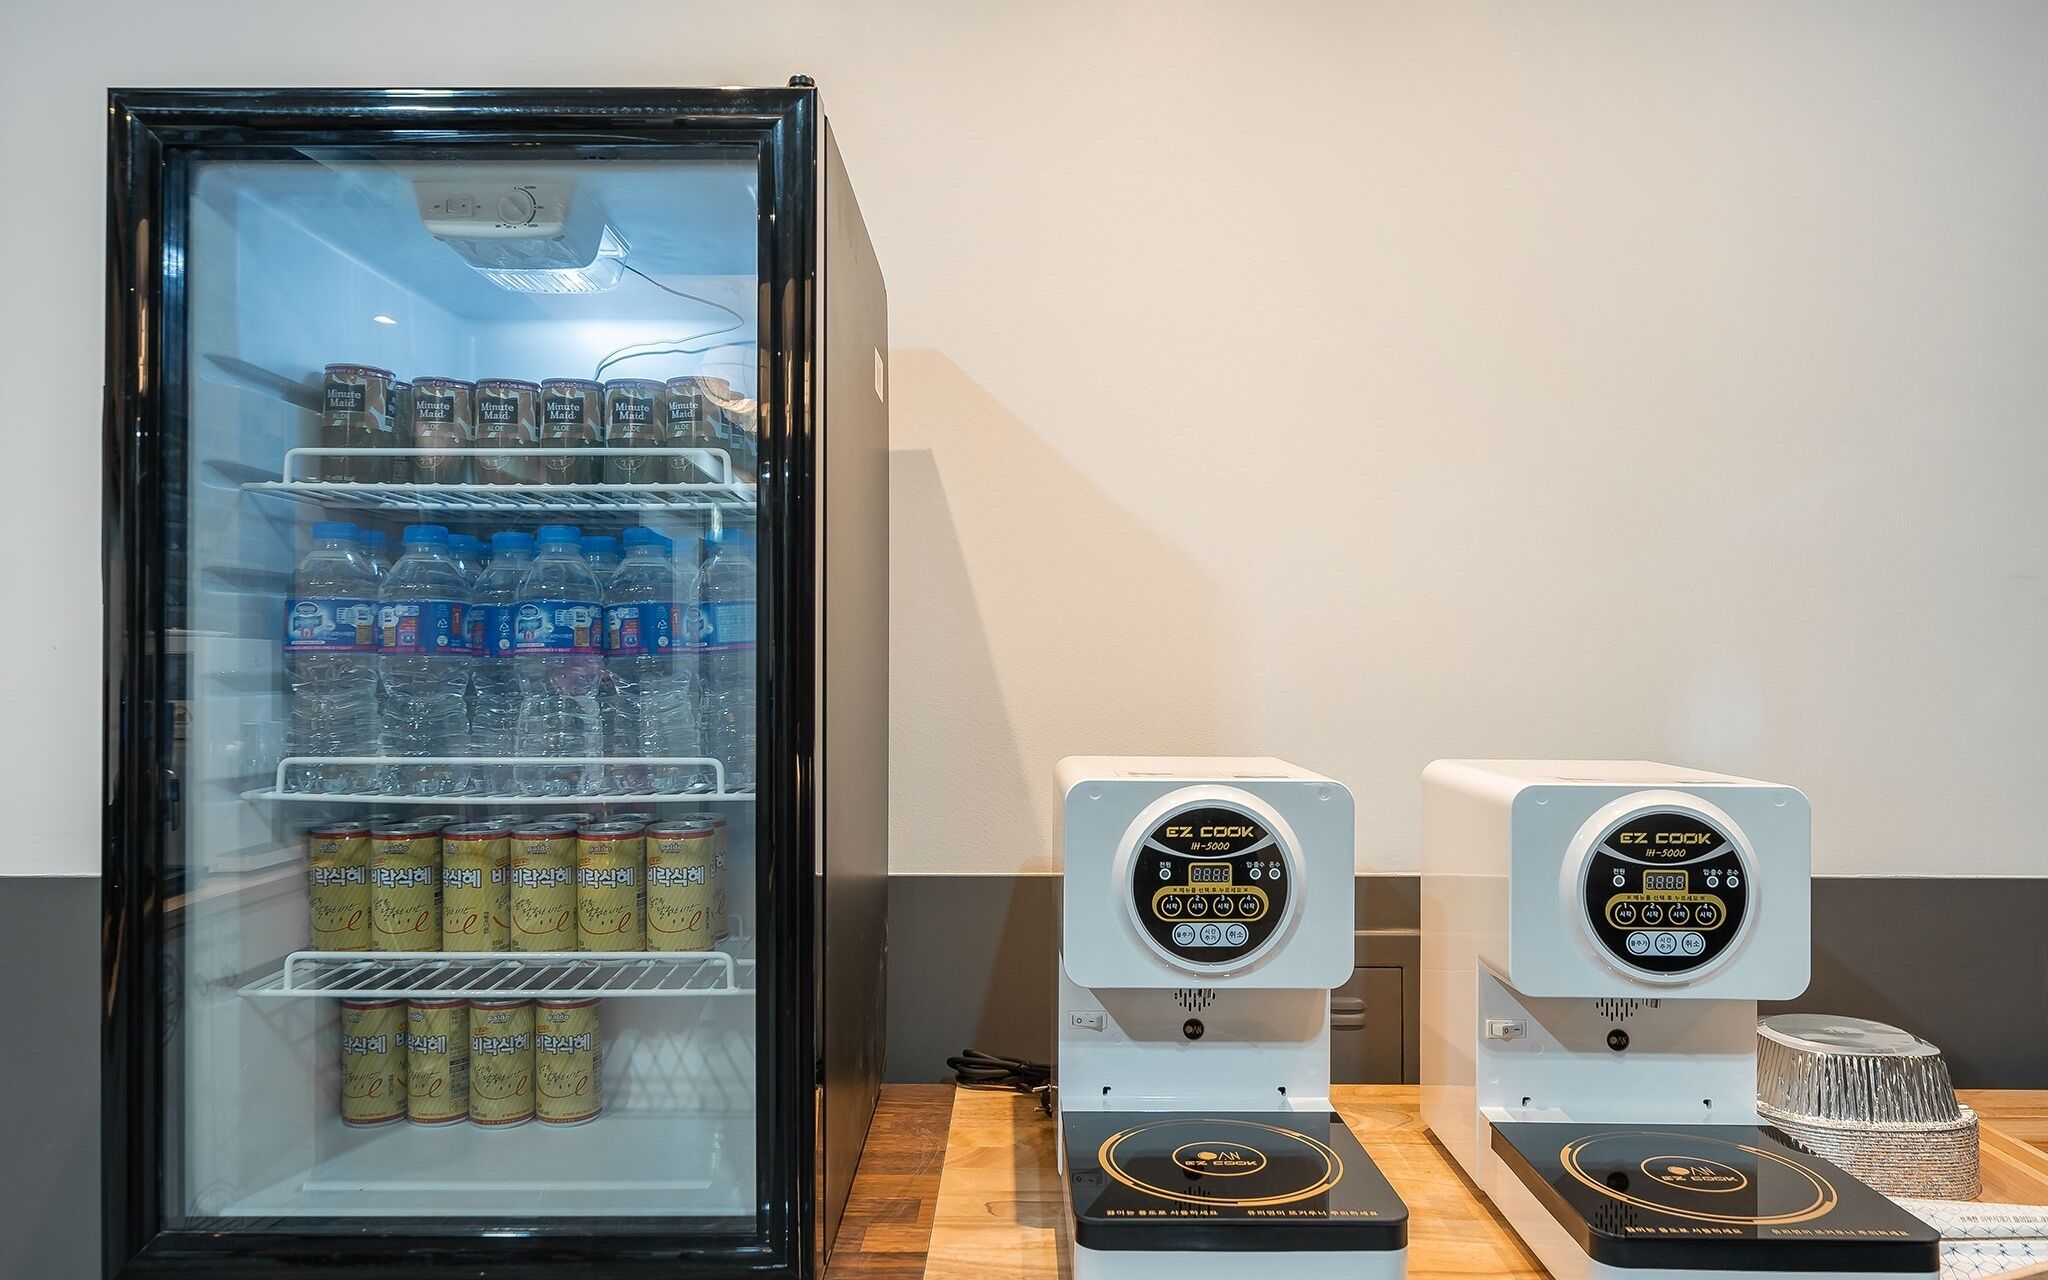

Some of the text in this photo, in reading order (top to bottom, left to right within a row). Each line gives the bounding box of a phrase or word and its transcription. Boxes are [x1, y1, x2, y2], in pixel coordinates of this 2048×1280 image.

[328, 388, 361, 399] Minute
[416, 401, 450, 410] Minute
[481, 402, 514, 412] Minute
[546, 402, 580, 412] Minute
[615, 403, 649, 413] Minute
[668, 401, 698, 411] Minute
[1166, 826, 1254, 837] EZ COOK
[1620, 833, 1711, 844] EZ COOK
[660, 843, 684, 853] paldo
[1230, 930, 1243, 938] 취소
